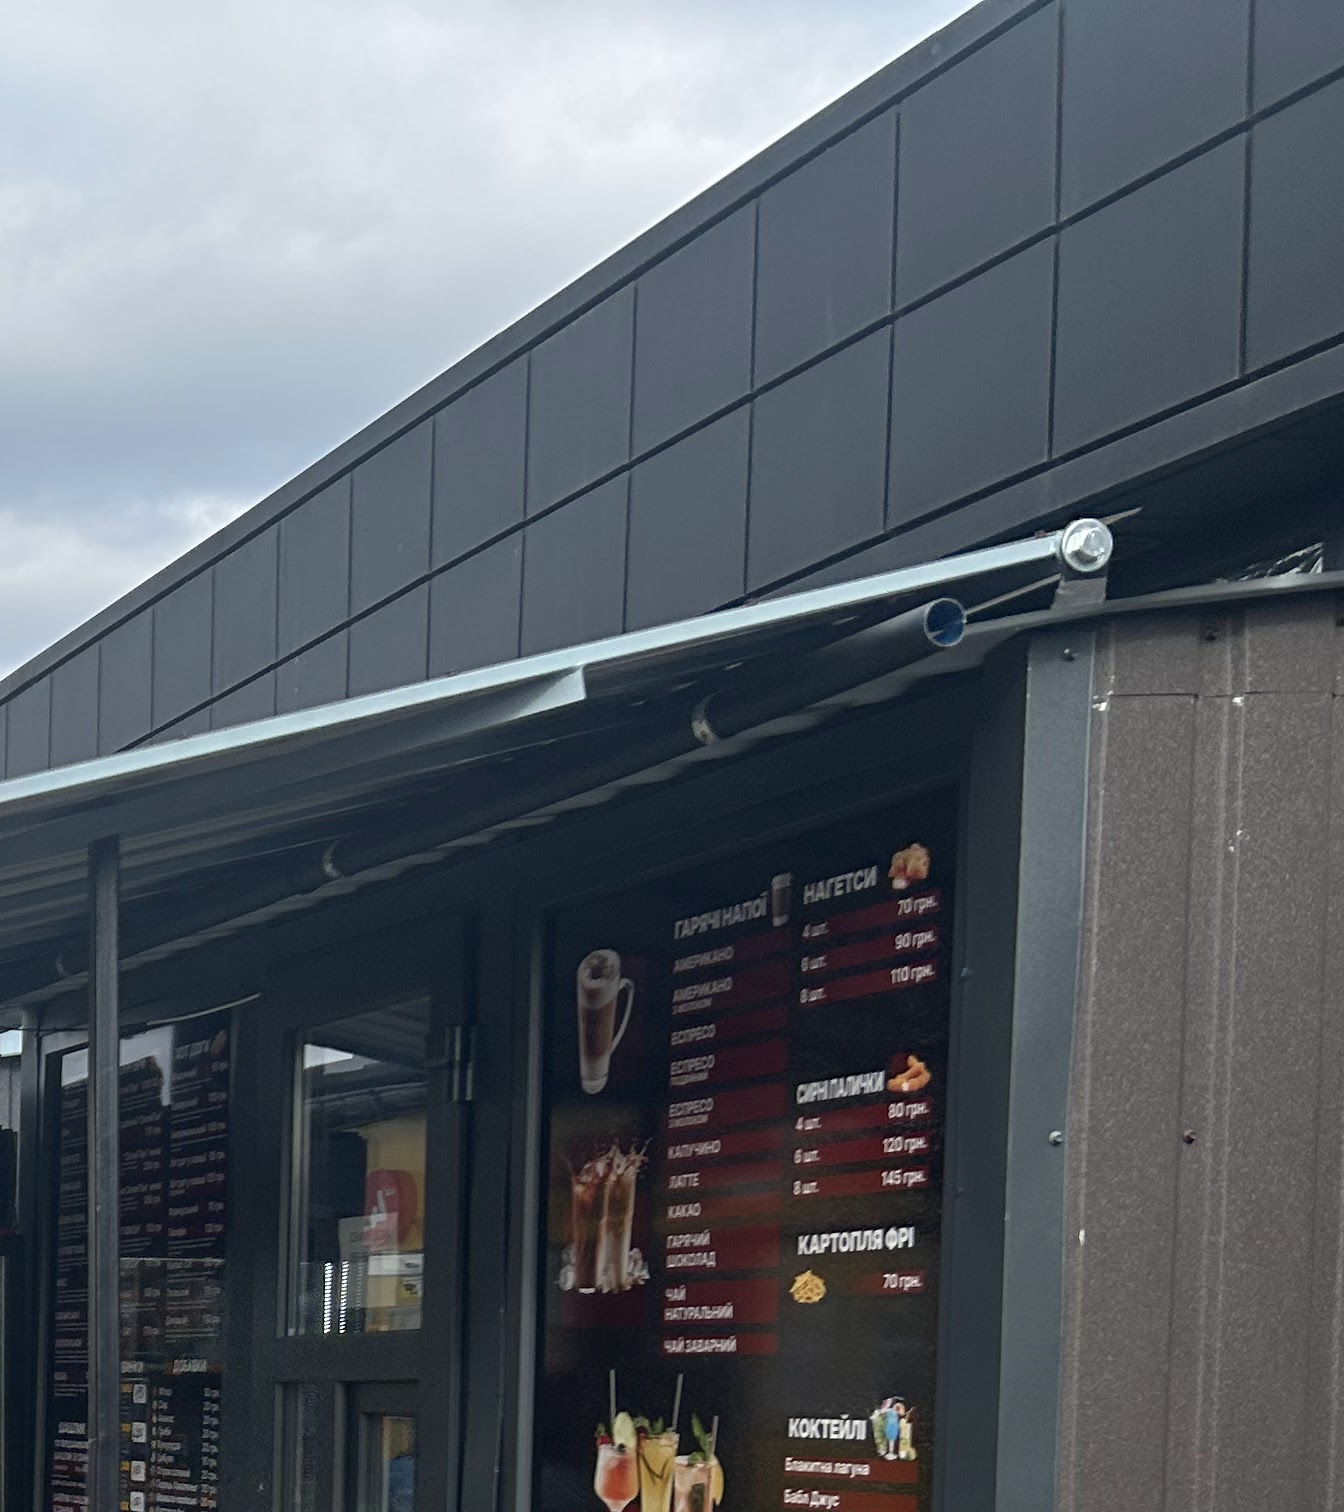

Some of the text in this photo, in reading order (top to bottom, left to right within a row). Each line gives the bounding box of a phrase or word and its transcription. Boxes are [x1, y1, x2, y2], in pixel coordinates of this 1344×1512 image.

[802, 865, 879, 905] НАГЕТСИ
[897, 897, 913, 915] 70
[914, 895, 939, 914] грн.
[912, 930, 937, 949] грн.
[890, 965, 910, 984] 110
[911, 964, 935, 982] грн.
[795, 1117, 804, 1131] 4
[888, 1102, 905, 1119] 80
[905, 1101, 930, 1119] грн.
[793, 1149, 802, 1164] 6
[882, 1136, 905, 1153] 120
[905, 1137, 928, 1154] грн.
[668, 1173, 700, 1189] ЛАТТЕ
[793, 1180, 802, 1195] 8
[881, 1169, 903, 1186] 145
[903, 1170, 927, 1187] грн.
[667, 1202, 701, 1219] КАКАО
[797, 1226, 916, 1256] КАРТОПЛЯ ФРІ
[883, 1273, 922, 1291] 70 грн.
[787, 1413, 867, 1441] КОКТЕЙЛІ
